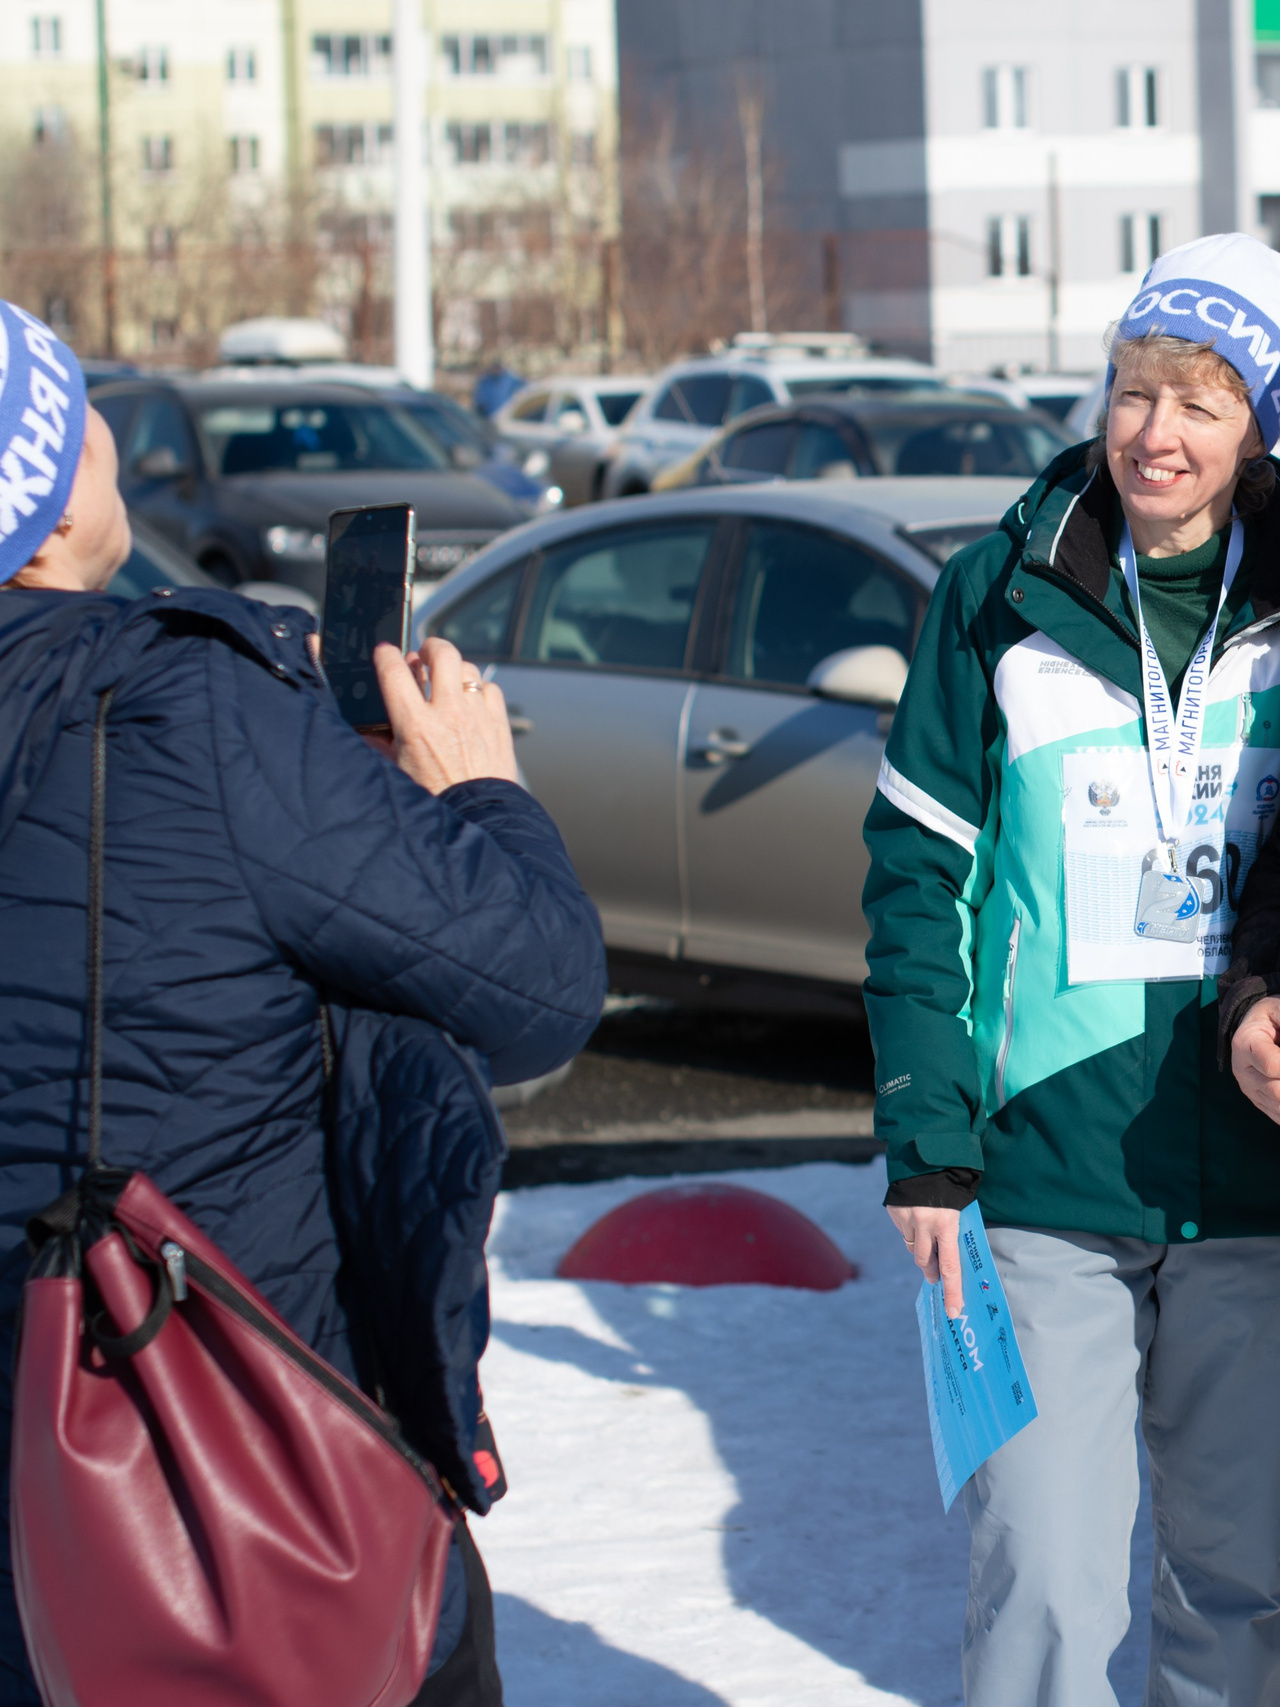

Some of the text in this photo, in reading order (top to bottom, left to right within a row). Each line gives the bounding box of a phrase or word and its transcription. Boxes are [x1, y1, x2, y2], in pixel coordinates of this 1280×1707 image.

[0, 366, 69, 546] ЖНЯ
[946, 1316, 968, 1371] ДАЕТСЯ
[957, 1314, 984, 1372] ЛОМ
